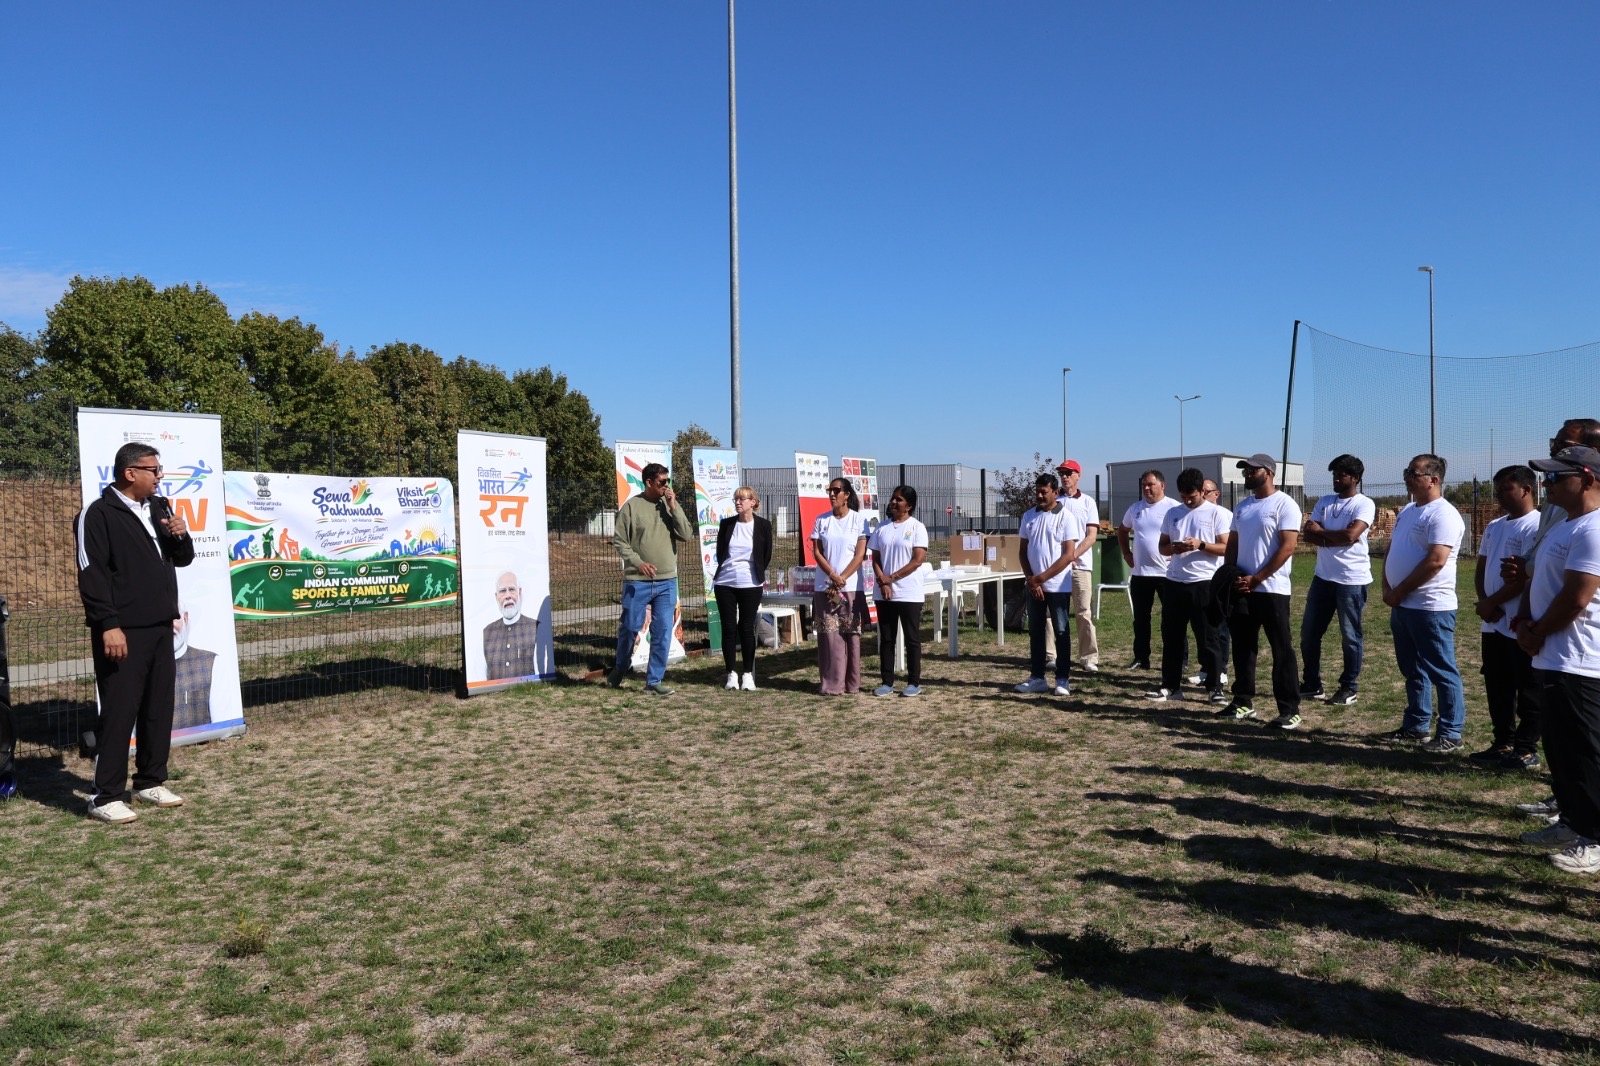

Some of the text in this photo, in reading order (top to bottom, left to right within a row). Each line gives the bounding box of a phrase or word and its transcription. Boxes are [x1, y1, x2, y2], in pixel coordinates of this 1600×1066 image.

[477, 466, 502, 479] विकसित
[396, 487, 423, 497] Viksit
[478, 479, 504, 494] भारत
[312, 487, 351, 505] Sewa
[398, 497, 429, 507] Bharat
[318, 503, 383, 516] Pakhwada
[479, 494, 529, 528] रन
[315, 530, 336, 540] Together
[321, 539, 343, 548] Greener
[344, 536, 353, 544] and
[304, 575, 399, 588] INDIAN COMMUNITY
[292, 584, 410, 600] SPORTS & FAMILY DAY
